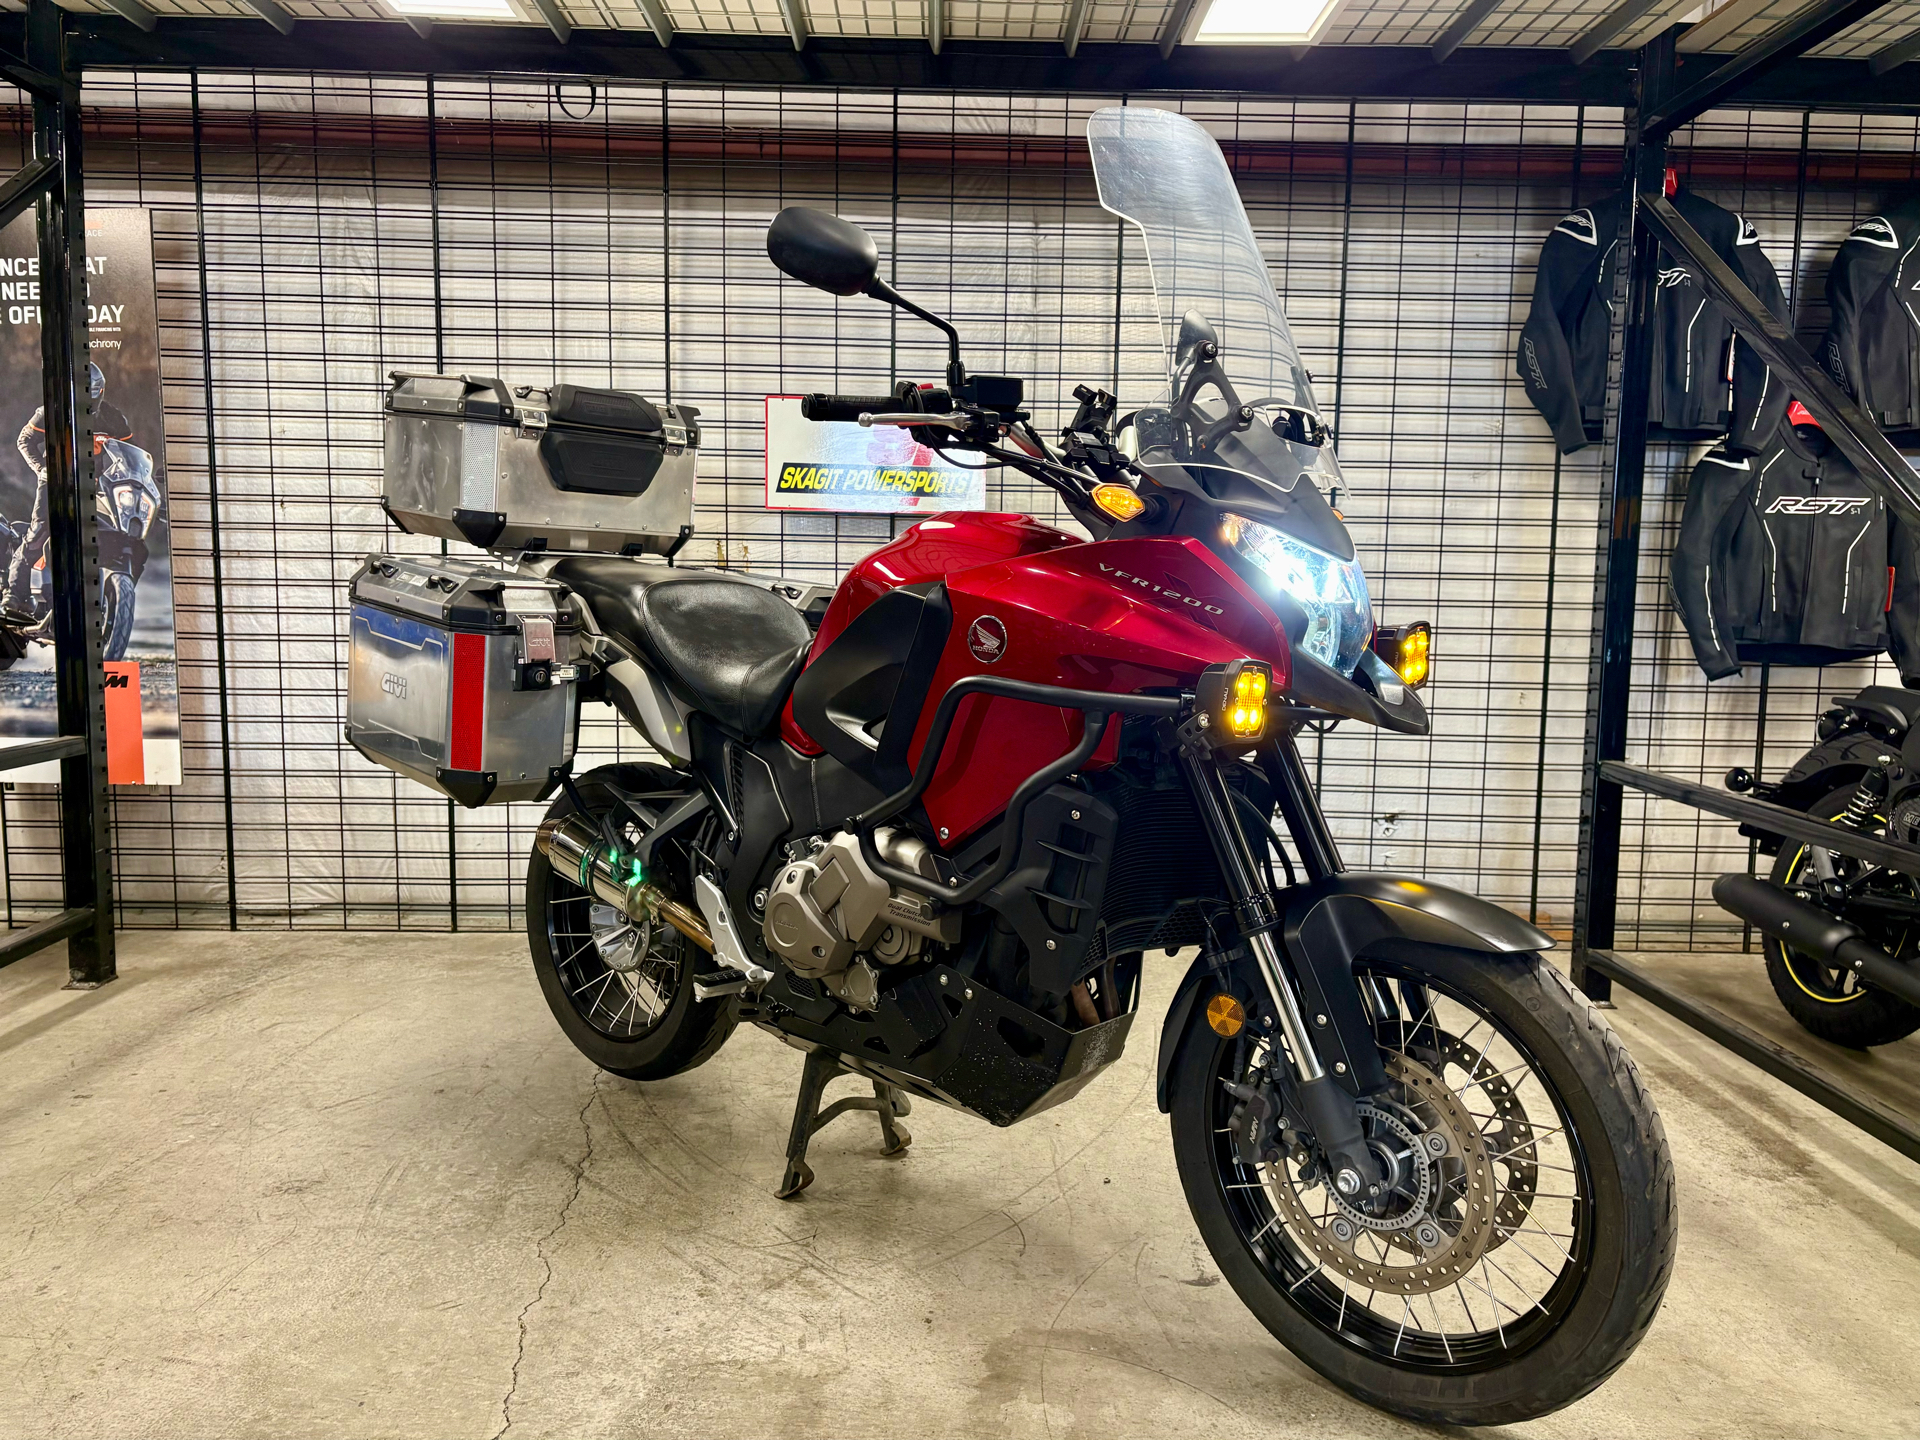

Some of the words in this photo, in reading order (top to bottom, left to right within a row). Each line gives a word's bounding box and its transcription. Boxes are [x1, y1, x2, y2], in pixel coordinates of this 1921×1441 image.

[1523, 335, 1548, 390] RST
[779, 466, 844, 491] SKAGIT
[842, 468, 972, 496] POWERSPORTS
[1764, 495, 1872, 516] RST
[1098, 562, 1225, 616] VFR1200
[972, 644, 1000, 655] HONDA
[380, 671, 408, 700] GIVI
[1221, 686, 1229, 712] DENALI
[888, 903, 902, 911] Dual
[890, 909, 931, 926] Transmission
